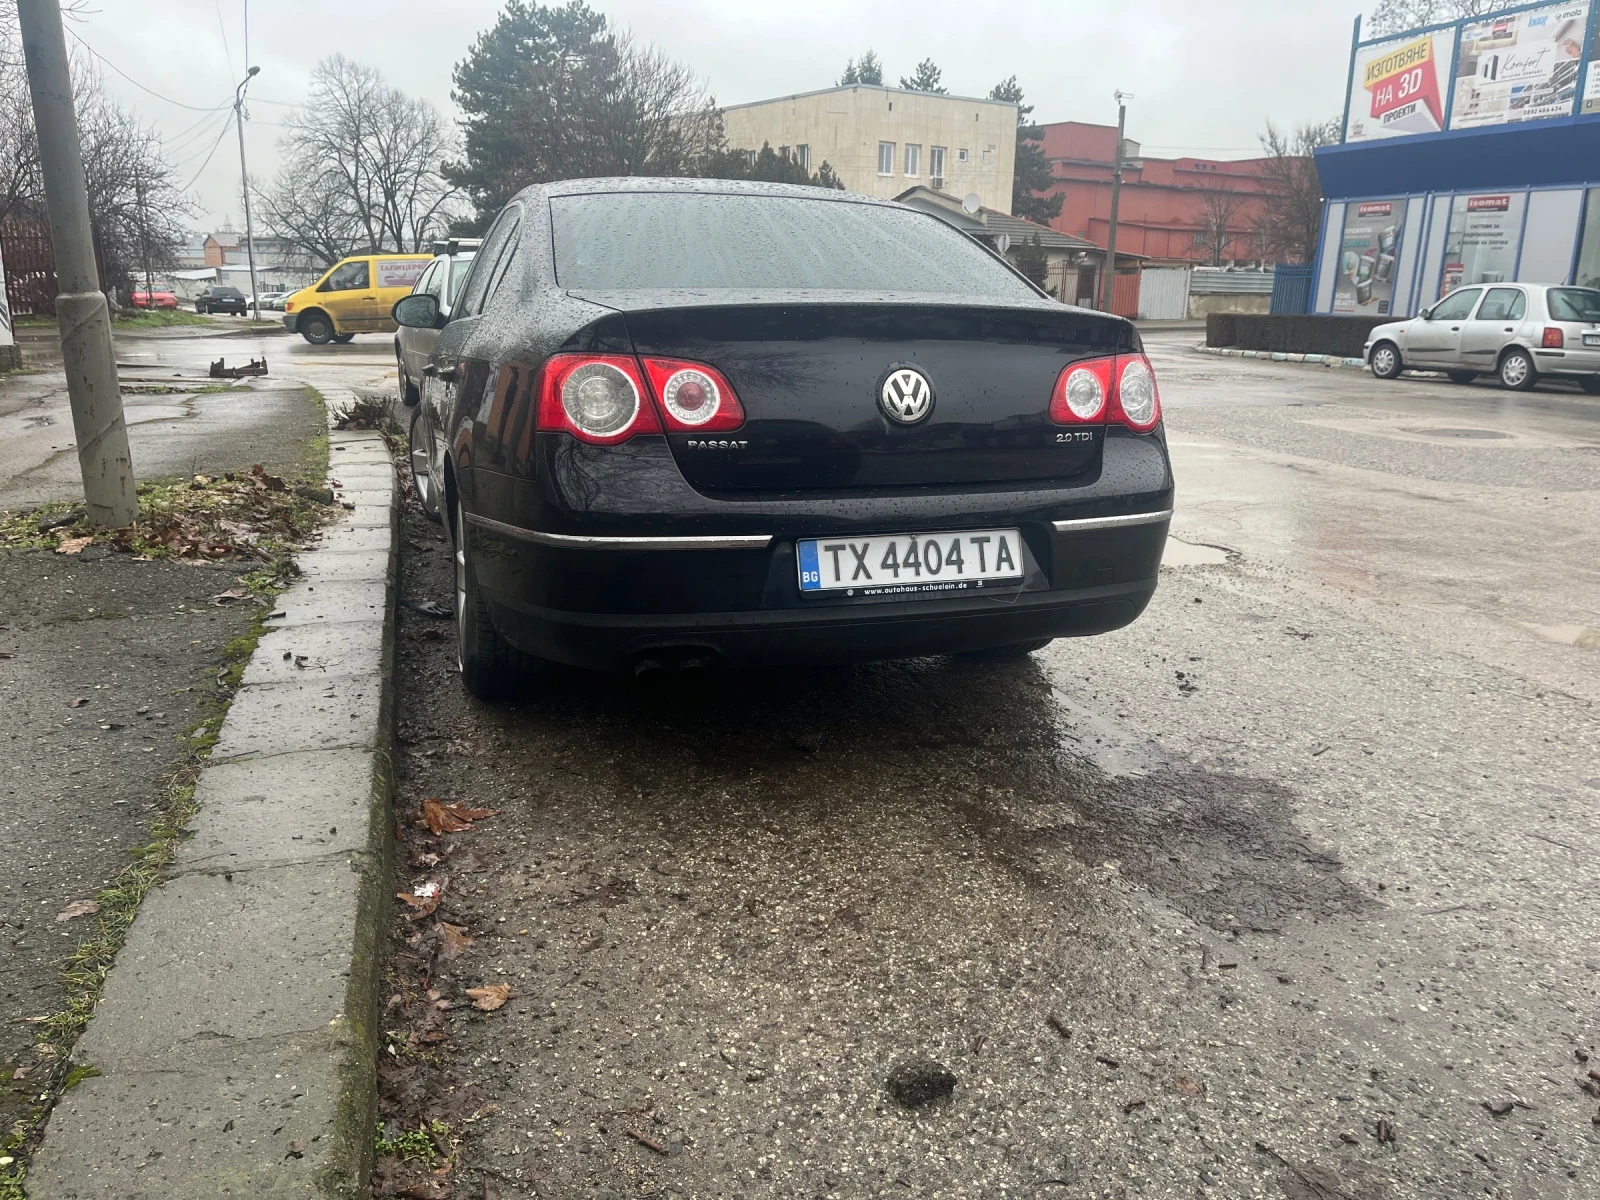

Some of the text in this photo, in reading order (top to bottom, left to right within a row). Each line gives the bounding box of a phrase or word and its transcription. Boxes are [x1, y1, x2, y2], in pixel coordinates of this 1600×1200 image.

[1562, 9, 1582, 19] imola
[1367, 42, 1428, 81] ИЗГОТВЯНЕ
[1501, 47, 1551, 74] Komfort
[1375, 67, 1422, 108] НА 3D
[1383, 103, 1416, 124] ПРОЕКТИ
[1360, 203, 1391, 213] isomat
[1469, 197, 1508, 207] isomat
[687, 440, 748, 450] PASSAT
[823, 535, 1016, 582] TX 4404 TA
[803, 571, 819, 583] BG
[864, 581, 968, 595] www.autohaus-schuelein.de
